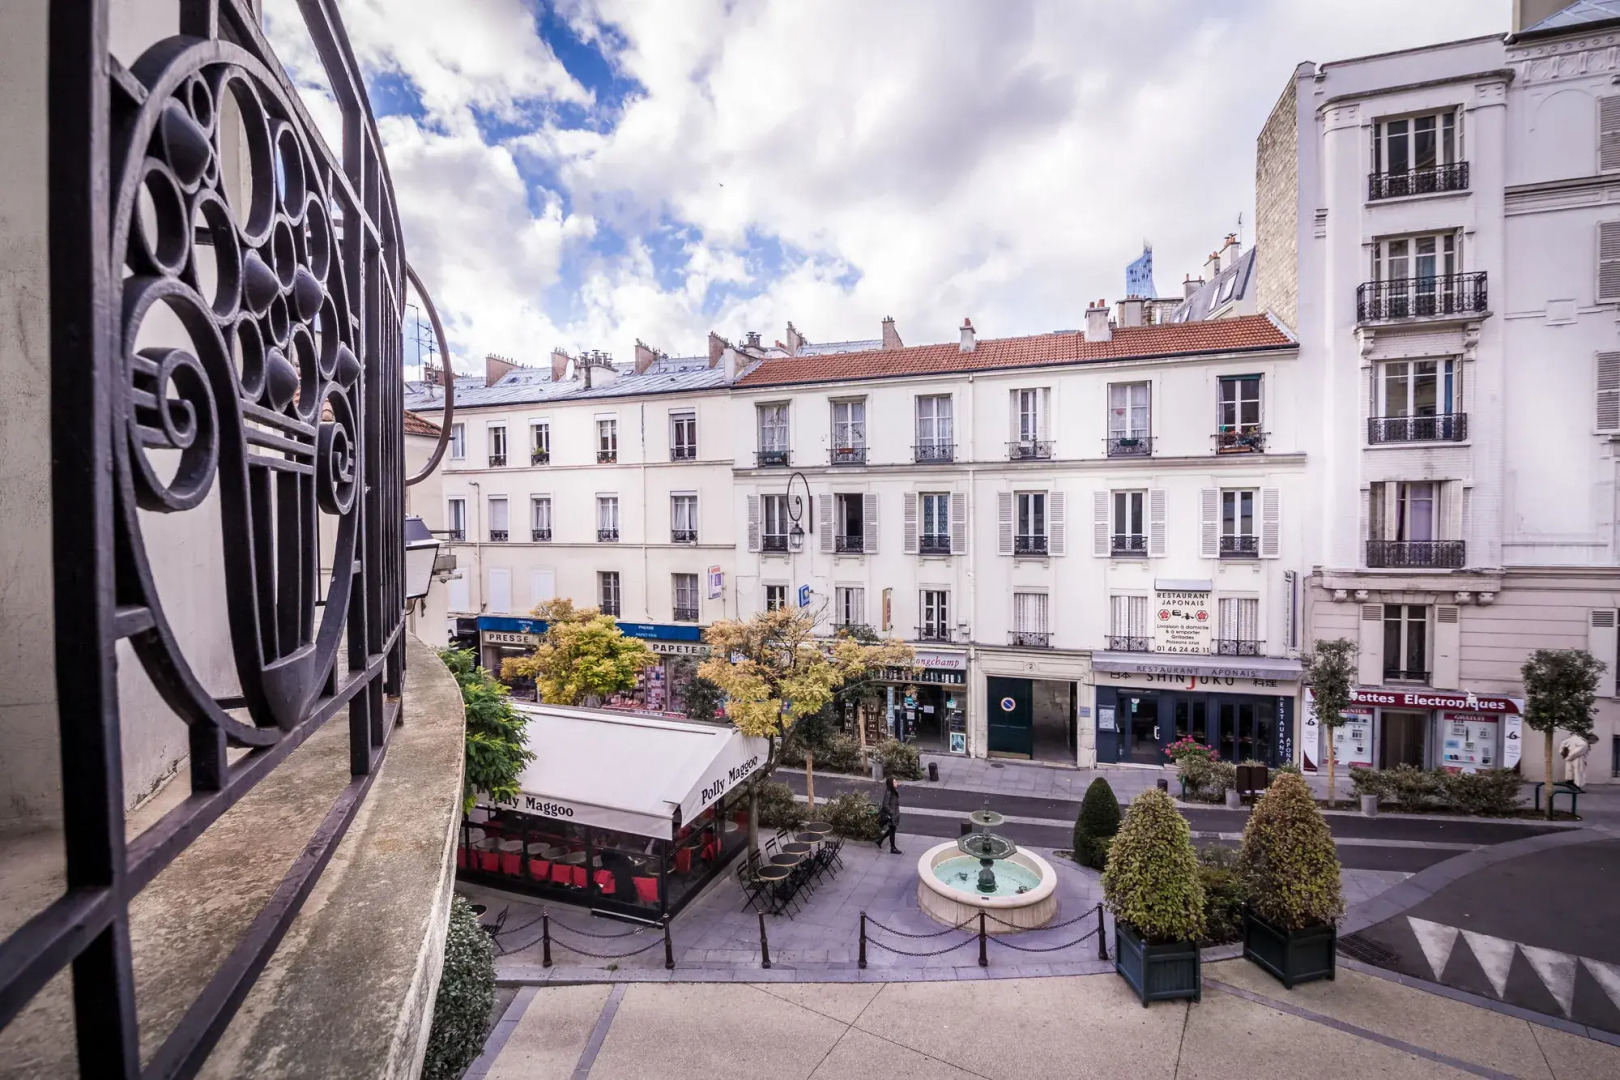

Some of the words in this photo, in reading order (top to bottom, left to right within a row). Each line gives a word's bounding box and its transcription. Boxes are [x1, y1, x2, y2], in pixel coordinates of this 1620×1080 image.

[489, 633, 529, 643] PRESSE
[913, 656, 959, 668] ongchamp
[1137, 665, 1198, 674] RESTAURANT
[1147, 673, 1235, 689] SHINJUKU
[1405, 694, 1505, 711] Electroniques
[701, 778, 725, 805] Polly
[729, 756, 758, 785] Maggoo
[525, 796, 574, 817] Maggoo
